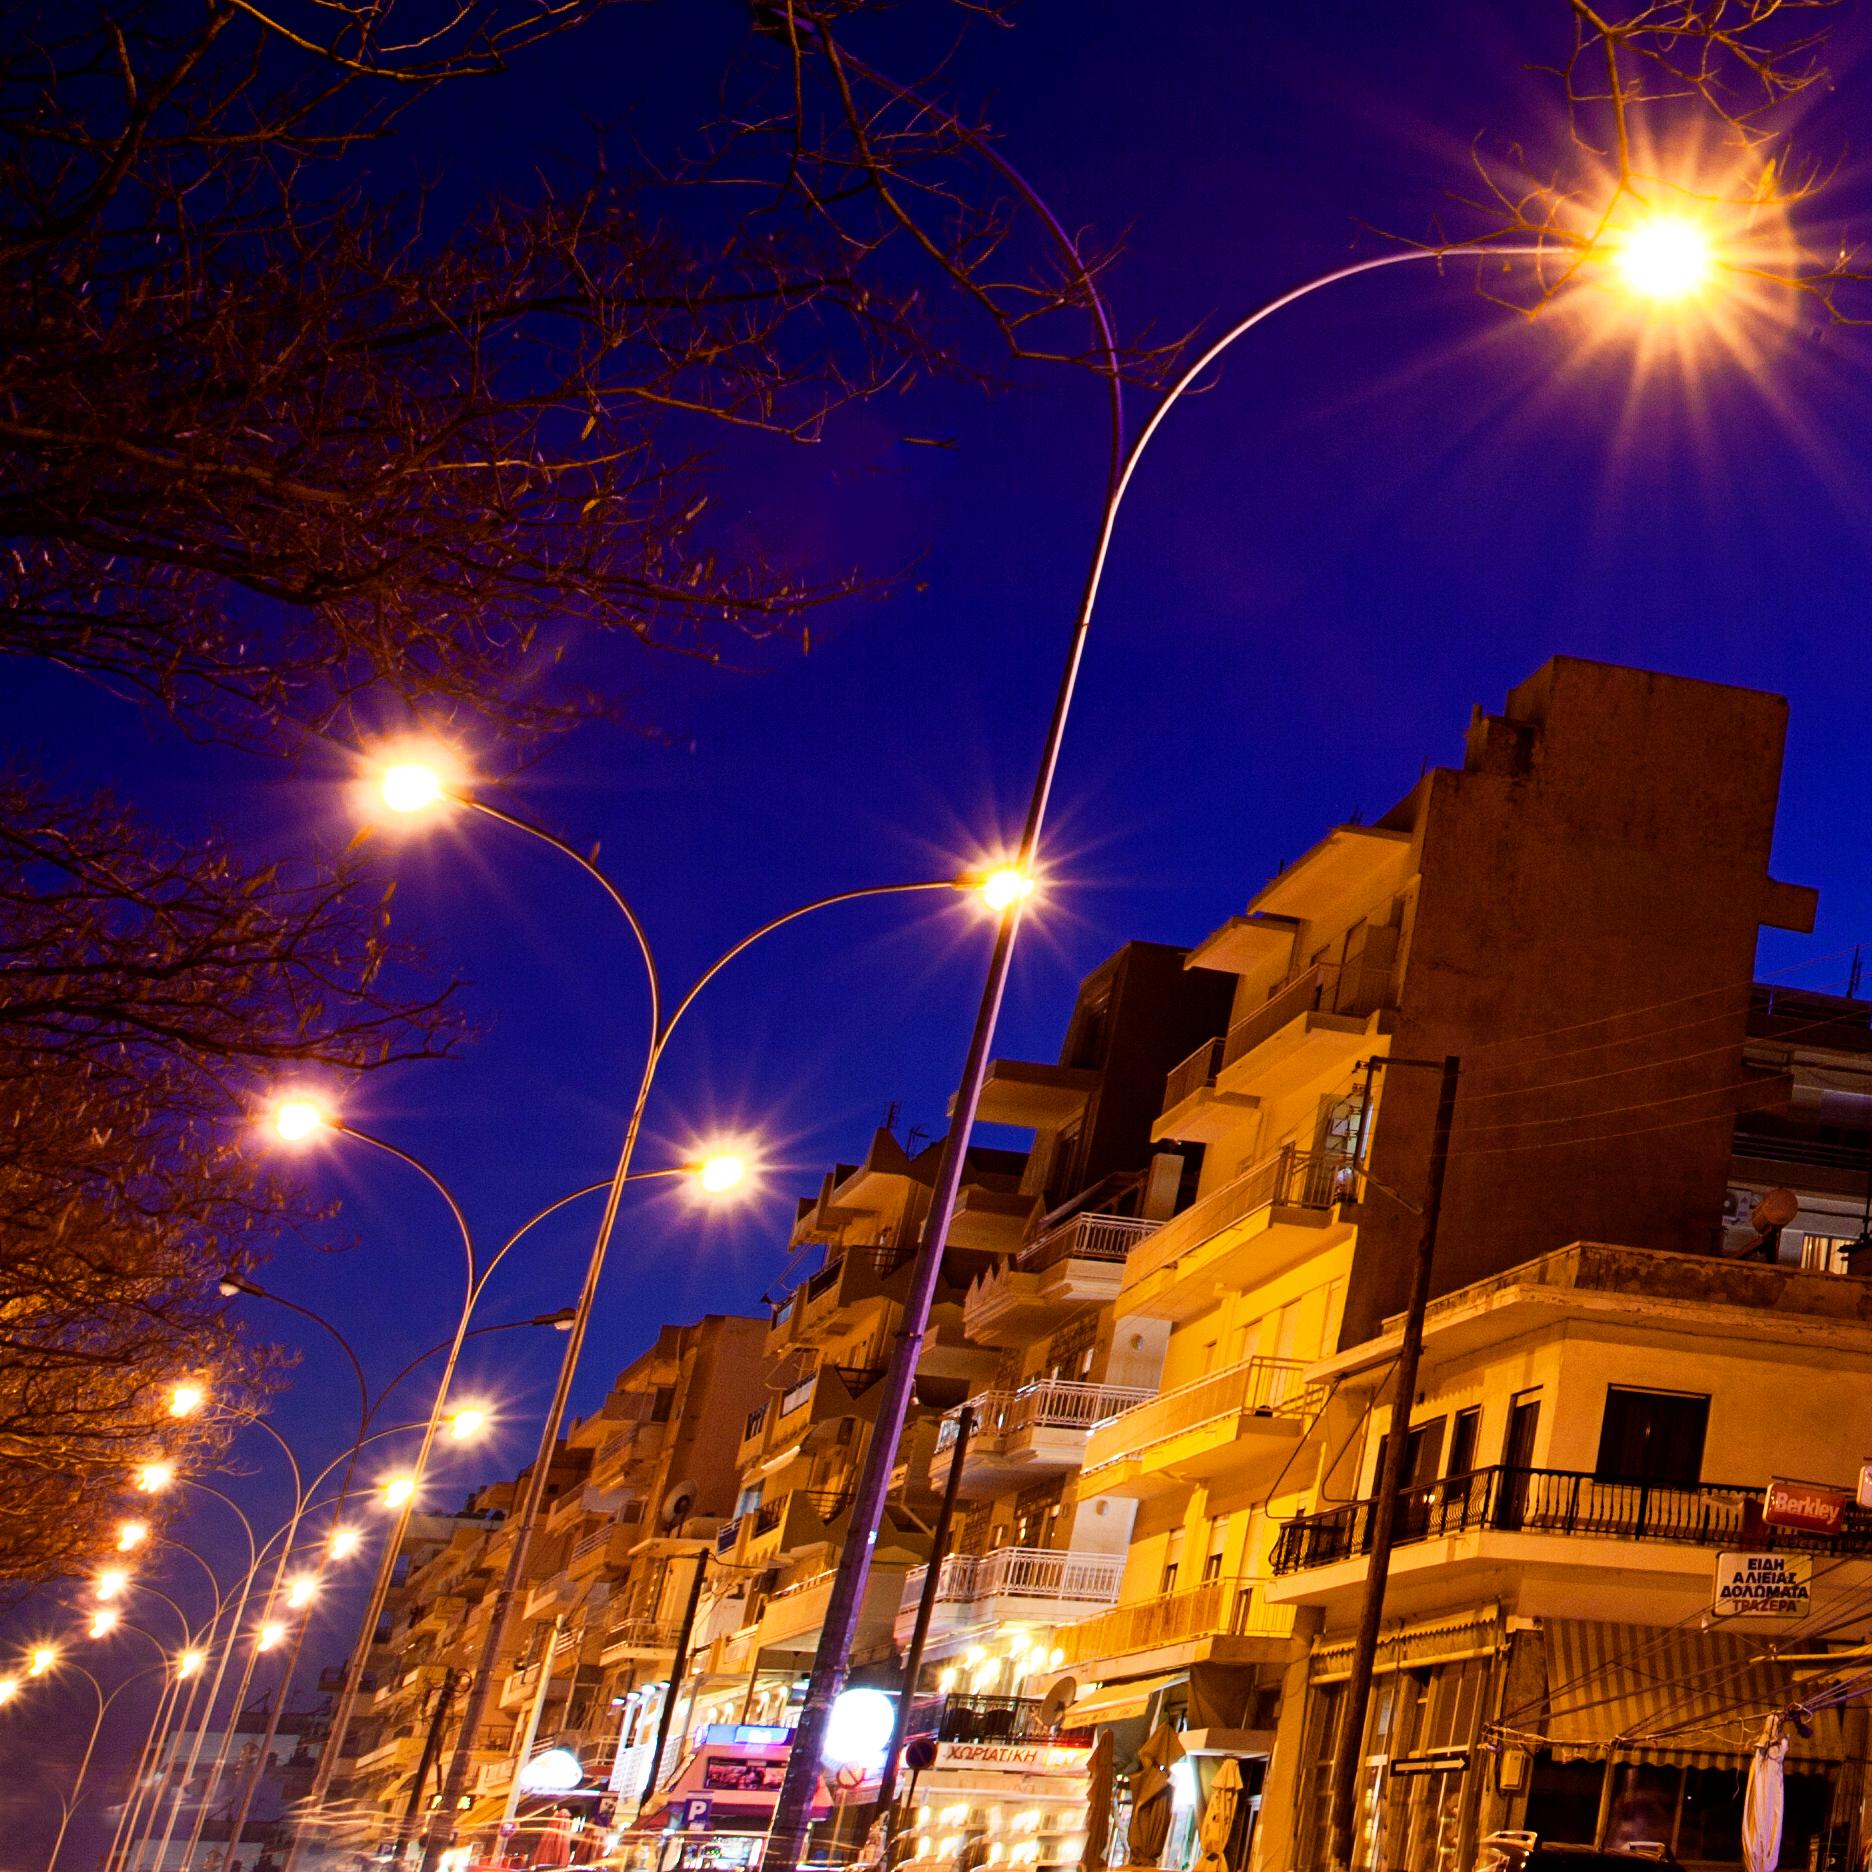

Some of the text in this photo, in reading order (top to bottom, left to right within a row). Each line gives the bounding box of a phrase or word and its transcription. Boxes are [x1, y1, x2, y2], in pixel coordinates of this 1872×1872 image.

[1775, 1492, 1840, 1525] Berkley
[1748, 1558, 1784, 1570] ΕΙΔΗ
[1733, 1572, 1797, 1584] ΑΛΙΕΙΑΣ
[1720, 1585, 1808, 1598] ΔΟΛΩΜΑΤΑ
[688, 1800, 707, 1821] P
